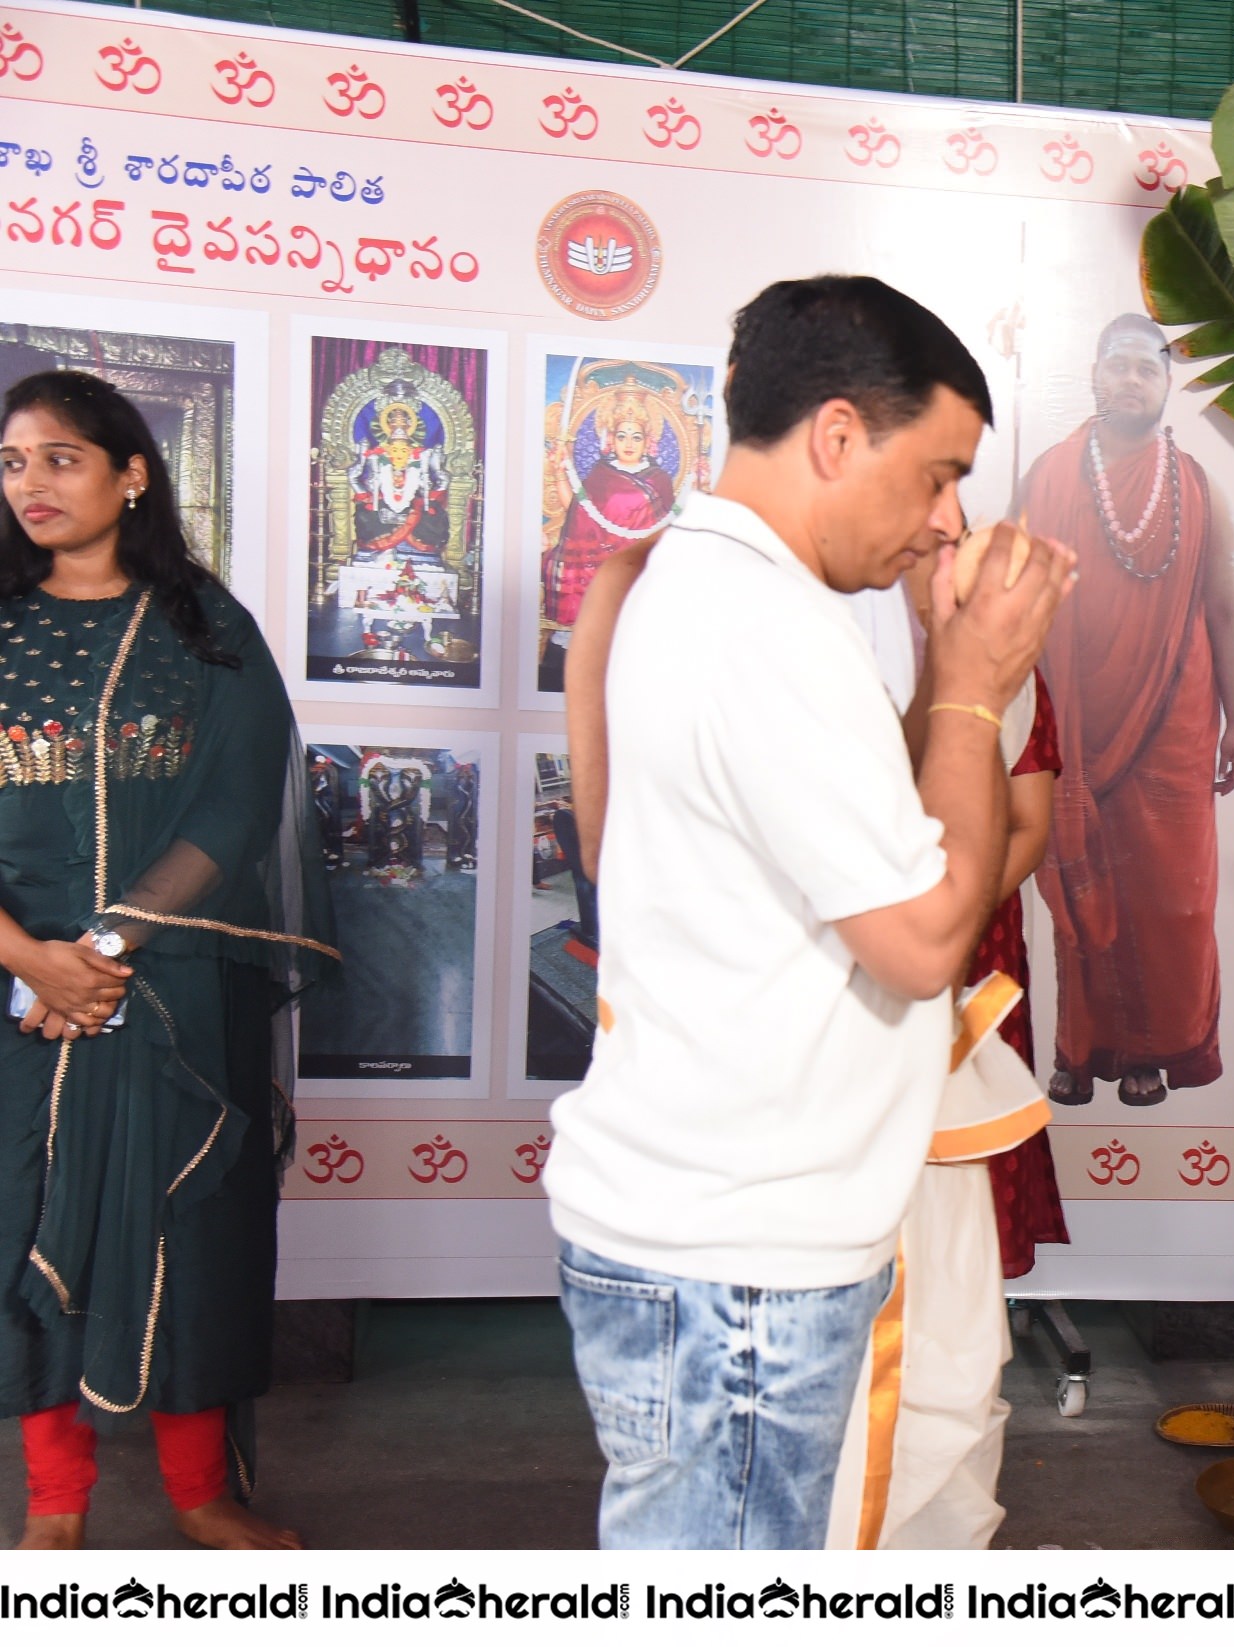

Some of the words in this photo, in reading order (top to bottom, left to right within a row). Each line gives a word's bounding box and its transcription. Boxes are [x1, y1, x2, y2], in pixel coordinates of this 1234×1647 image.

[75, 137, 105, 188] శ్రీ
[124, 154, 272, 194] శారదాపీఠ
[290, 167, 385, 205] పాలిత
[150, 209, 480, 294] దైవసన్నిధానం
